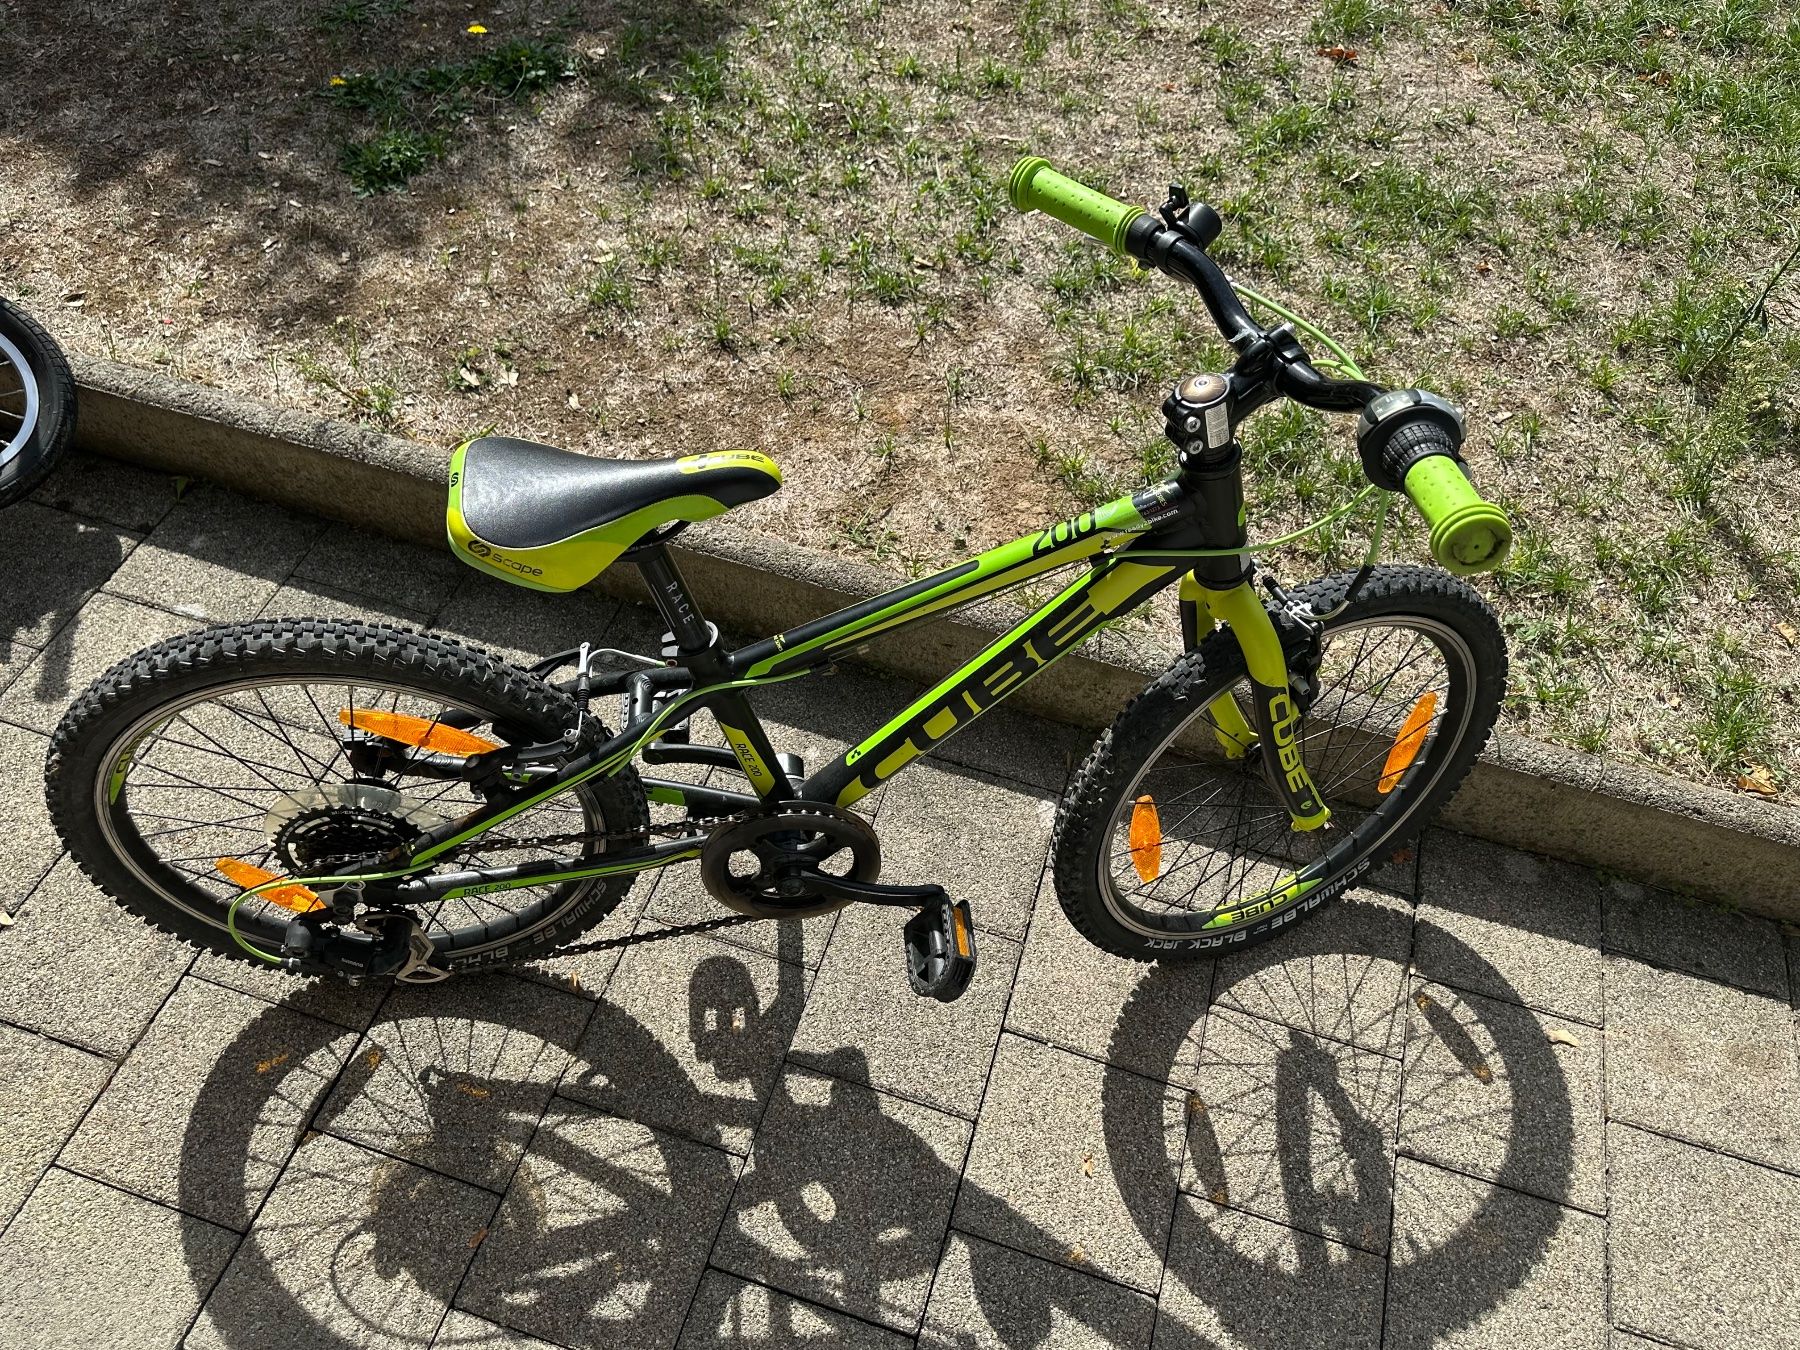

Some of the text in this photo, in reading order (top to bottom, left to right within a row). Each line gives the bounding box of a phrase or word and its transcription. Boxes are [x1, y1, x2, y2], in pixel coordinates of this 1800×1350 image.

[1032, 509, 1097, 556] 200
[665, 580, 695, 625] RACE
[858, 586, 1107, 791] CUBE
[735, 743, 755, 762] RACE
[1268, 693, 1308, 793] CUBE
[463, 882, 511, 896] RACE 200
[533, 878, 608, 945] SCHWALBE
[1143, 857, 1371, 950] SCHWALBE BLACK JACK
[1230, 893, 1288, 923] CUBE
